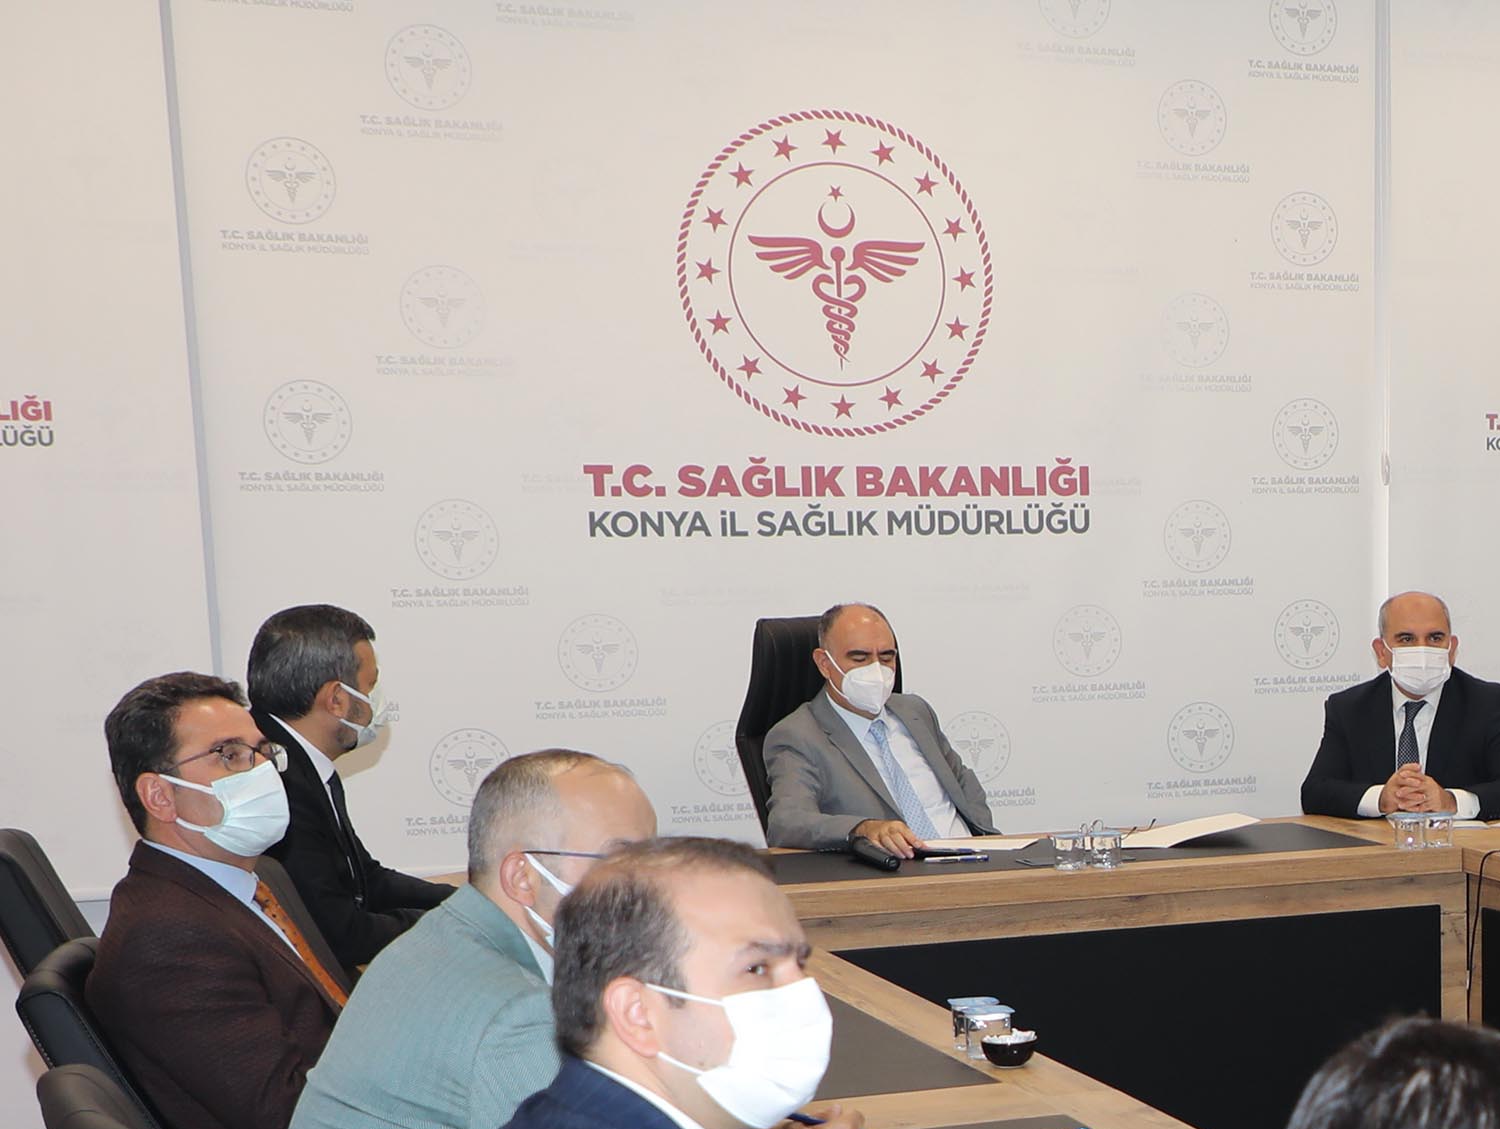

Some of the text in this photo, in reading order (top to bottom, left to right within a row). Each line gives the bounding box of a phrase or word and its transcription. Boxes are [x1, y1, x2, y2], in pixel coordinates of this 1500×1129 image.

[220, 230, 244, 240] T.C.
[0, 425, 54, 446] ÜĞÜ
[238, 470, 384, 482] T.C. SAĞLIK BAKANLIĞI
[583, 465, 665, 497] T.C.
[677, 457, 845, 497] SAĞLIK
[856, 457, 1089, 497] BAKANLIĞI
[588, 511, 711, 538] KONYA
[757, 503, 877, 537] SAĞLIK
[887, 502, 1091, 536] MÜDÜRLÜĞÜ
[390, 589, 413, 598] T.C.
[416, 586, 462, 597] SAĞLIK
[1032, 686, 1051, 694] T.C.
[534, 701, 556, 710] T.C.
[987, 786, 1035, 797] AKANLIĞI
[1146, 782, 1164, 790] T.C.
[672, 806, 691, 814] T.C.
[694, 802, 734, 813] SAĞLIK
[405, 817, 427, 827] T.C.
